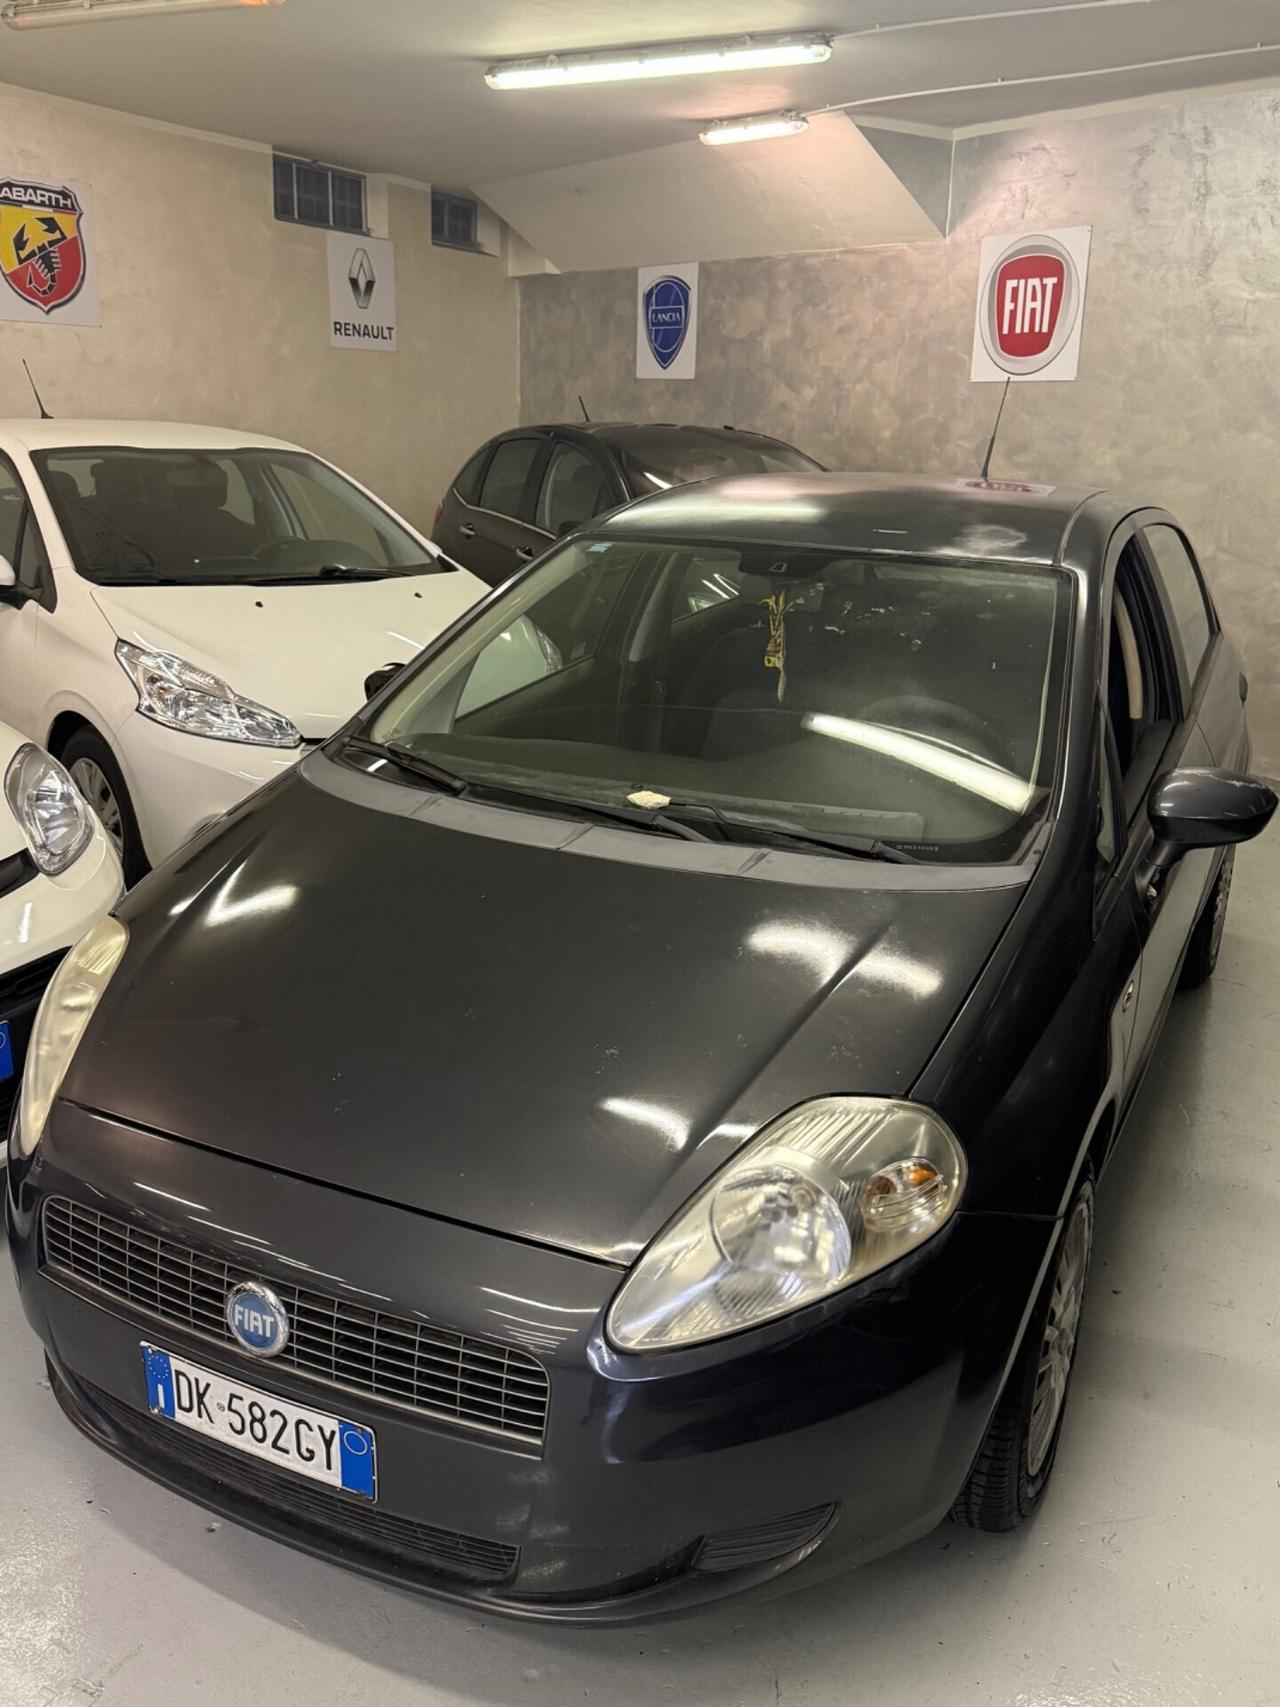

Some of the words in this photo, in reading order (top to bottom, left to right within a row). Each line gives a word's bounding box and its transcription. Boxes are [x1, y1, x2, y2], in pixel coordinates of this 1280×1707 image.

[0, 187, 72, 208] ABARTH
[652, 312, 681, 323] LANCIA
[1002, 277, 1058, 335] FIAT
[334, 321, 394, 340] RENAULT
[234, 1304, 275, 1338] FIAT
[174, 1369, 214, 1425] DK
[227, 1392, 337, 1471] 582GY
